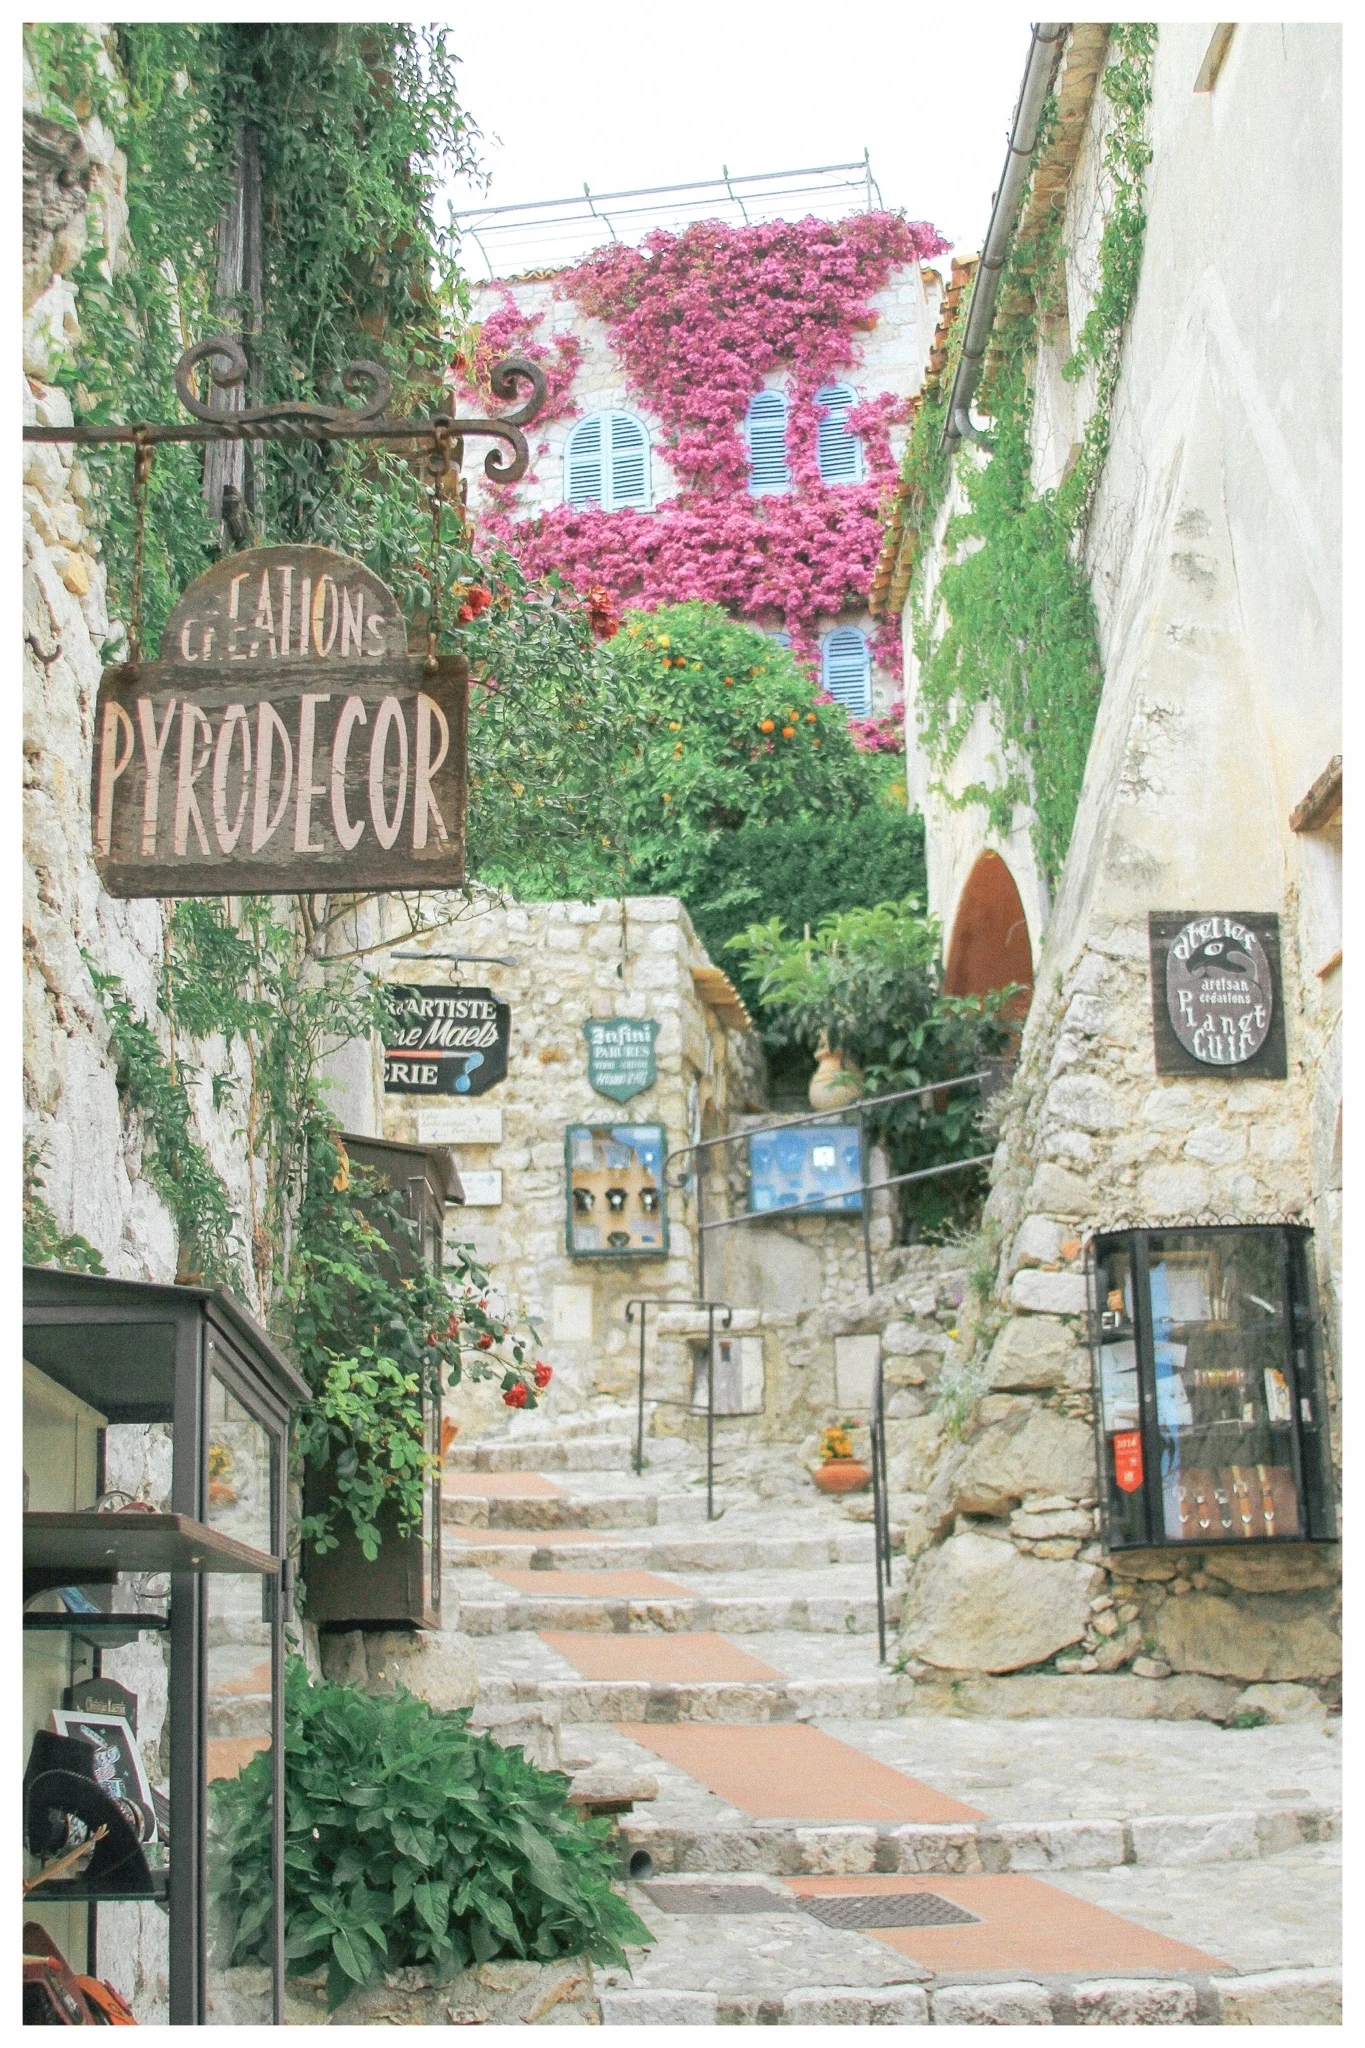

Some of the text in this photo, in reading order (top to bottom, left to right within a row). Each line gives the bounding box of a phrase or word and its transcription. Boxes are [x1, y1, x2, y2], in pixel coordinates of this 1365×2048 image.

[96, 692, 450, 858] PYRODECOR
[1201, 978, 1249, 991] artisan
[1177, 989, 1266, 1035] Planet
[592, 1024, 651, 1046] Infini
[1192, 1027, 1255, 1061] Cuir
